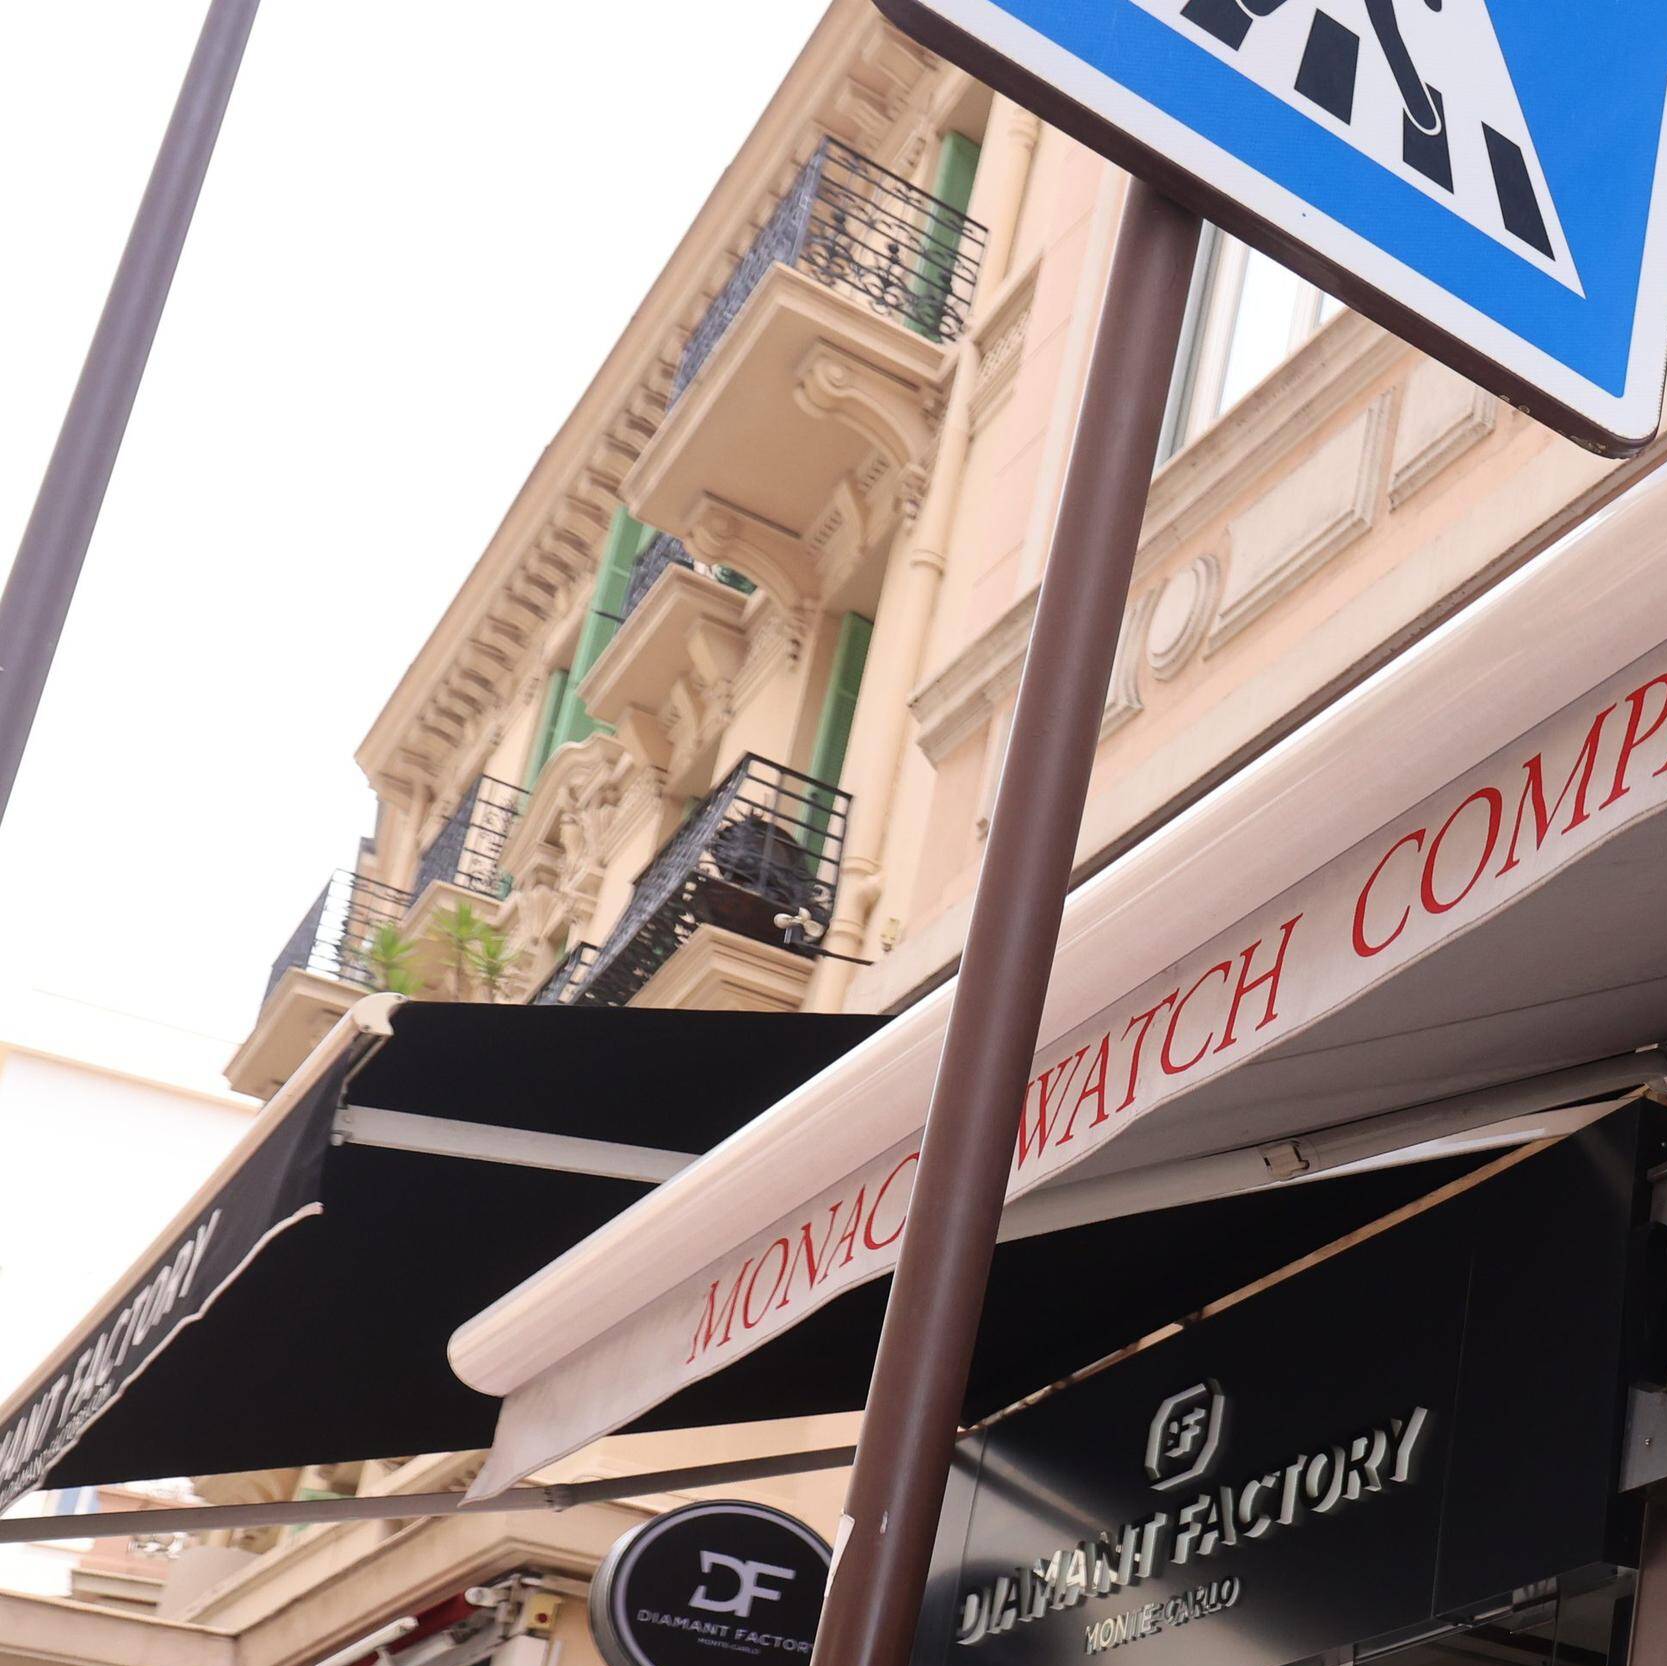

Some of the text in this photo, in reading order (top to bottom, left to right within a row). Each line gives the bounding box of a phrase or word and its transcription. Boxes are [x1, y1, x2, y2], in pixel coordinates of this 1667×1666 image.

[685, 1151, 921, 1365] MONAC
[636, 1609, 814, 1654] DIAMANT FACTOR
[957, 1406, 1429, 1646] DIAMANT FACTORY
